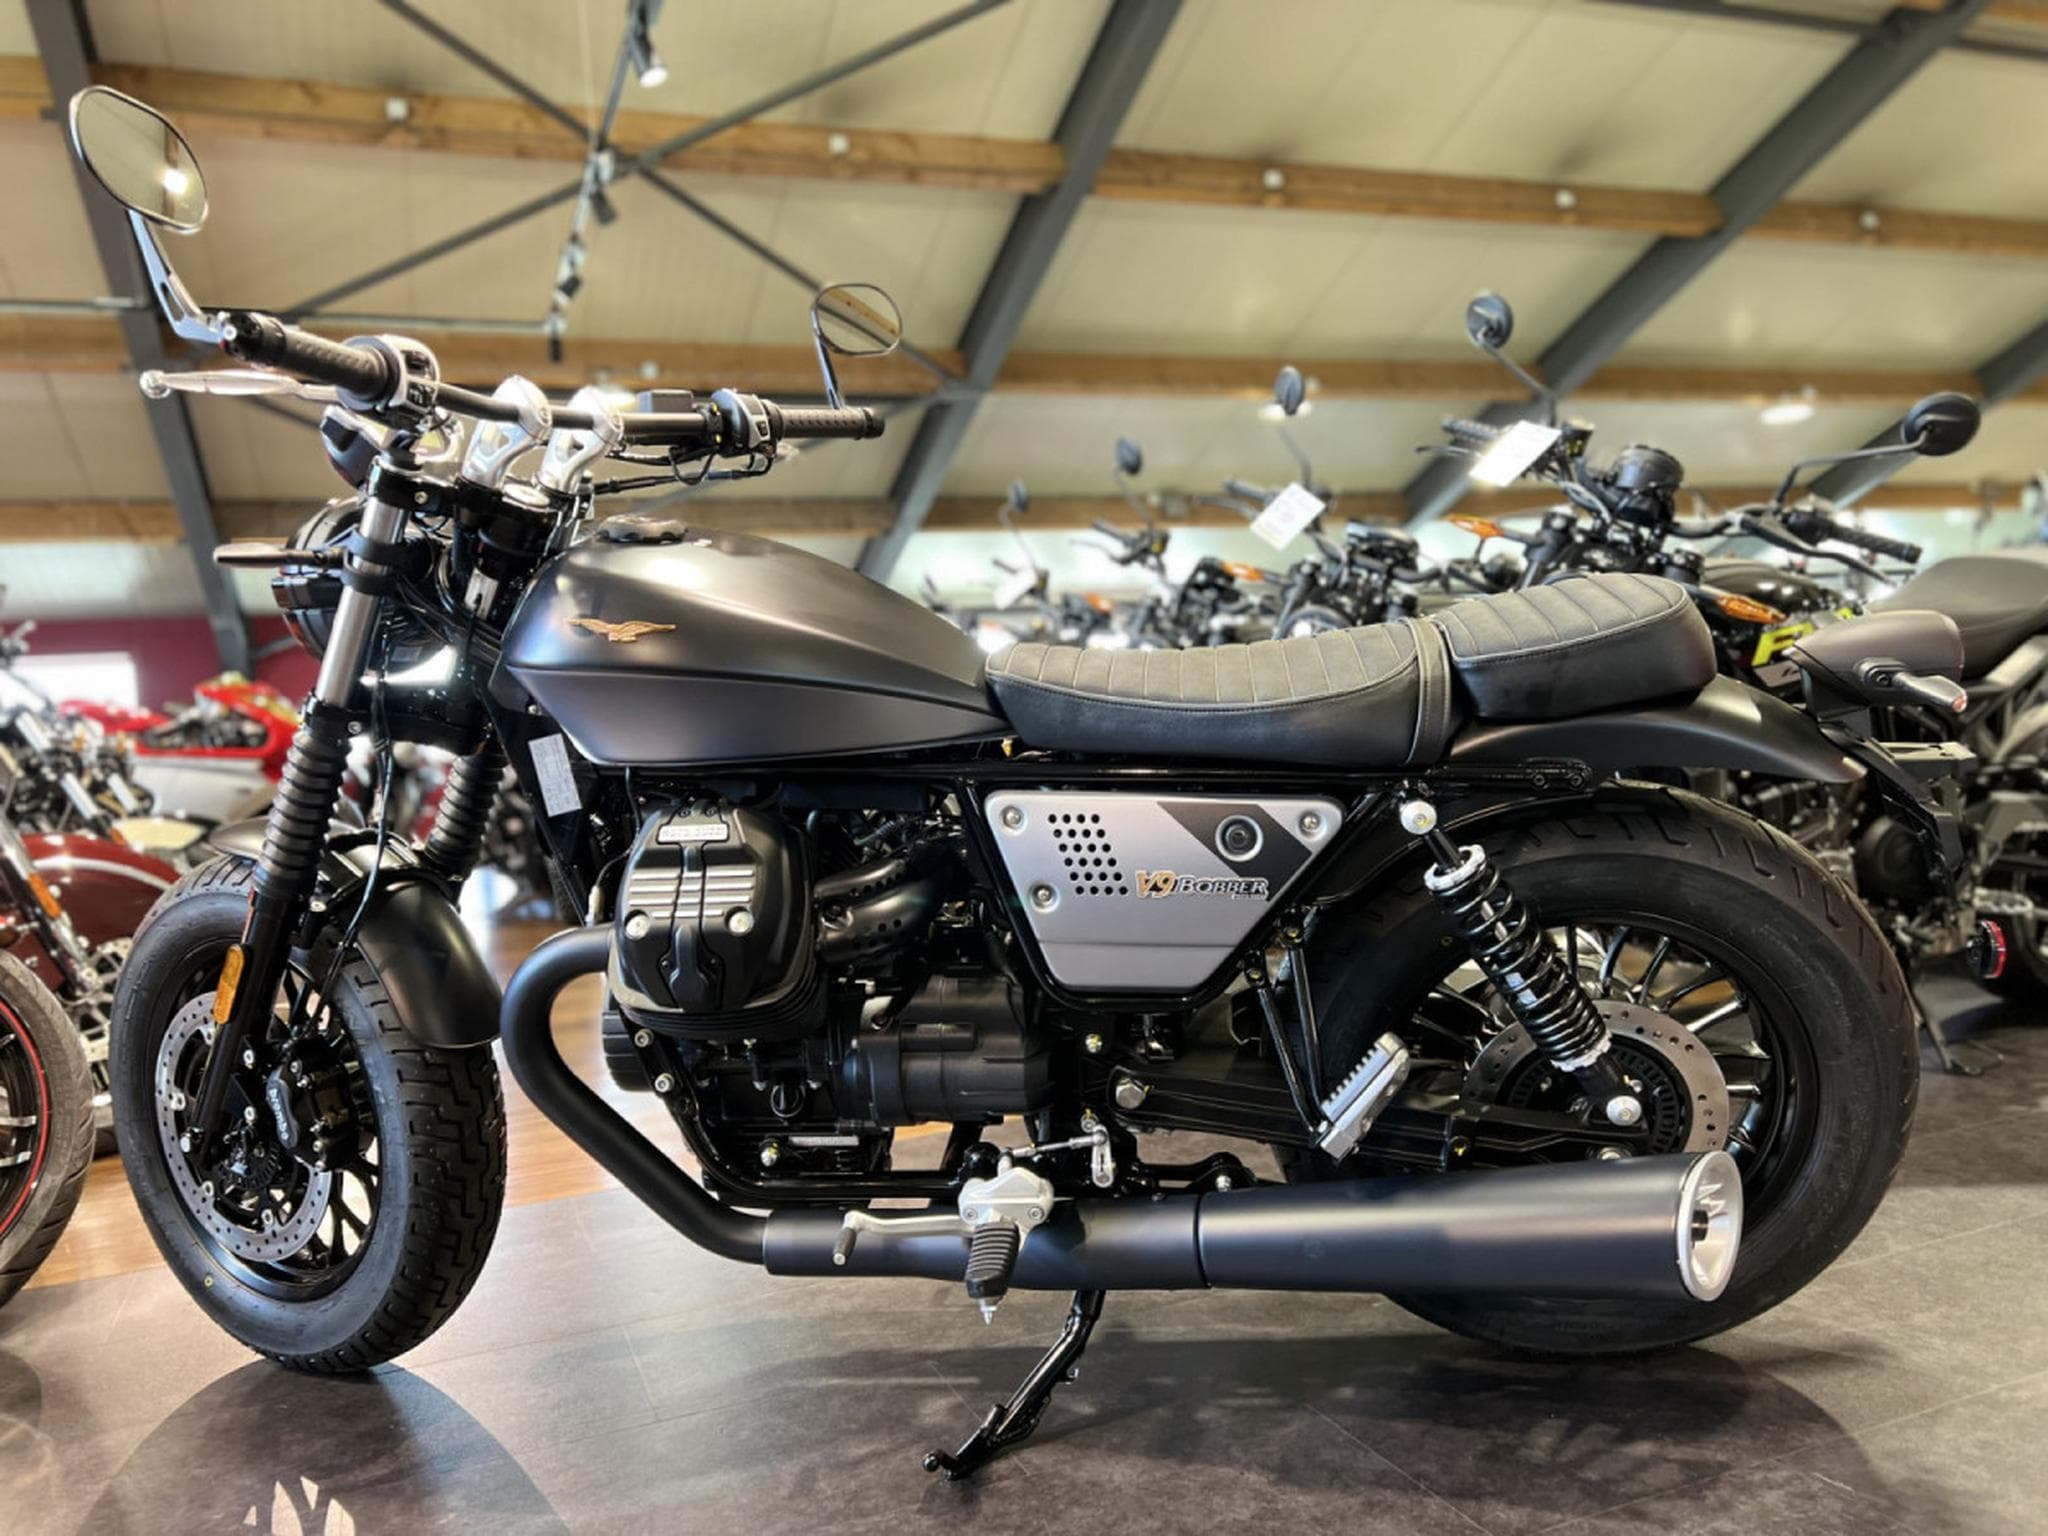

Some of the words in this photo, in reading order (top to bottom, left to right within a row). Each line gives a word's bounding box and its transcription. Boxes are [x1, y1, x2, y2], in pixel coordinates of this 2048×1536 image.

[1136, 869, 1176, 898] V9
[1177, 875, 1269, 896] BOBBER
[268, 1087, 289, 1140] brembo
